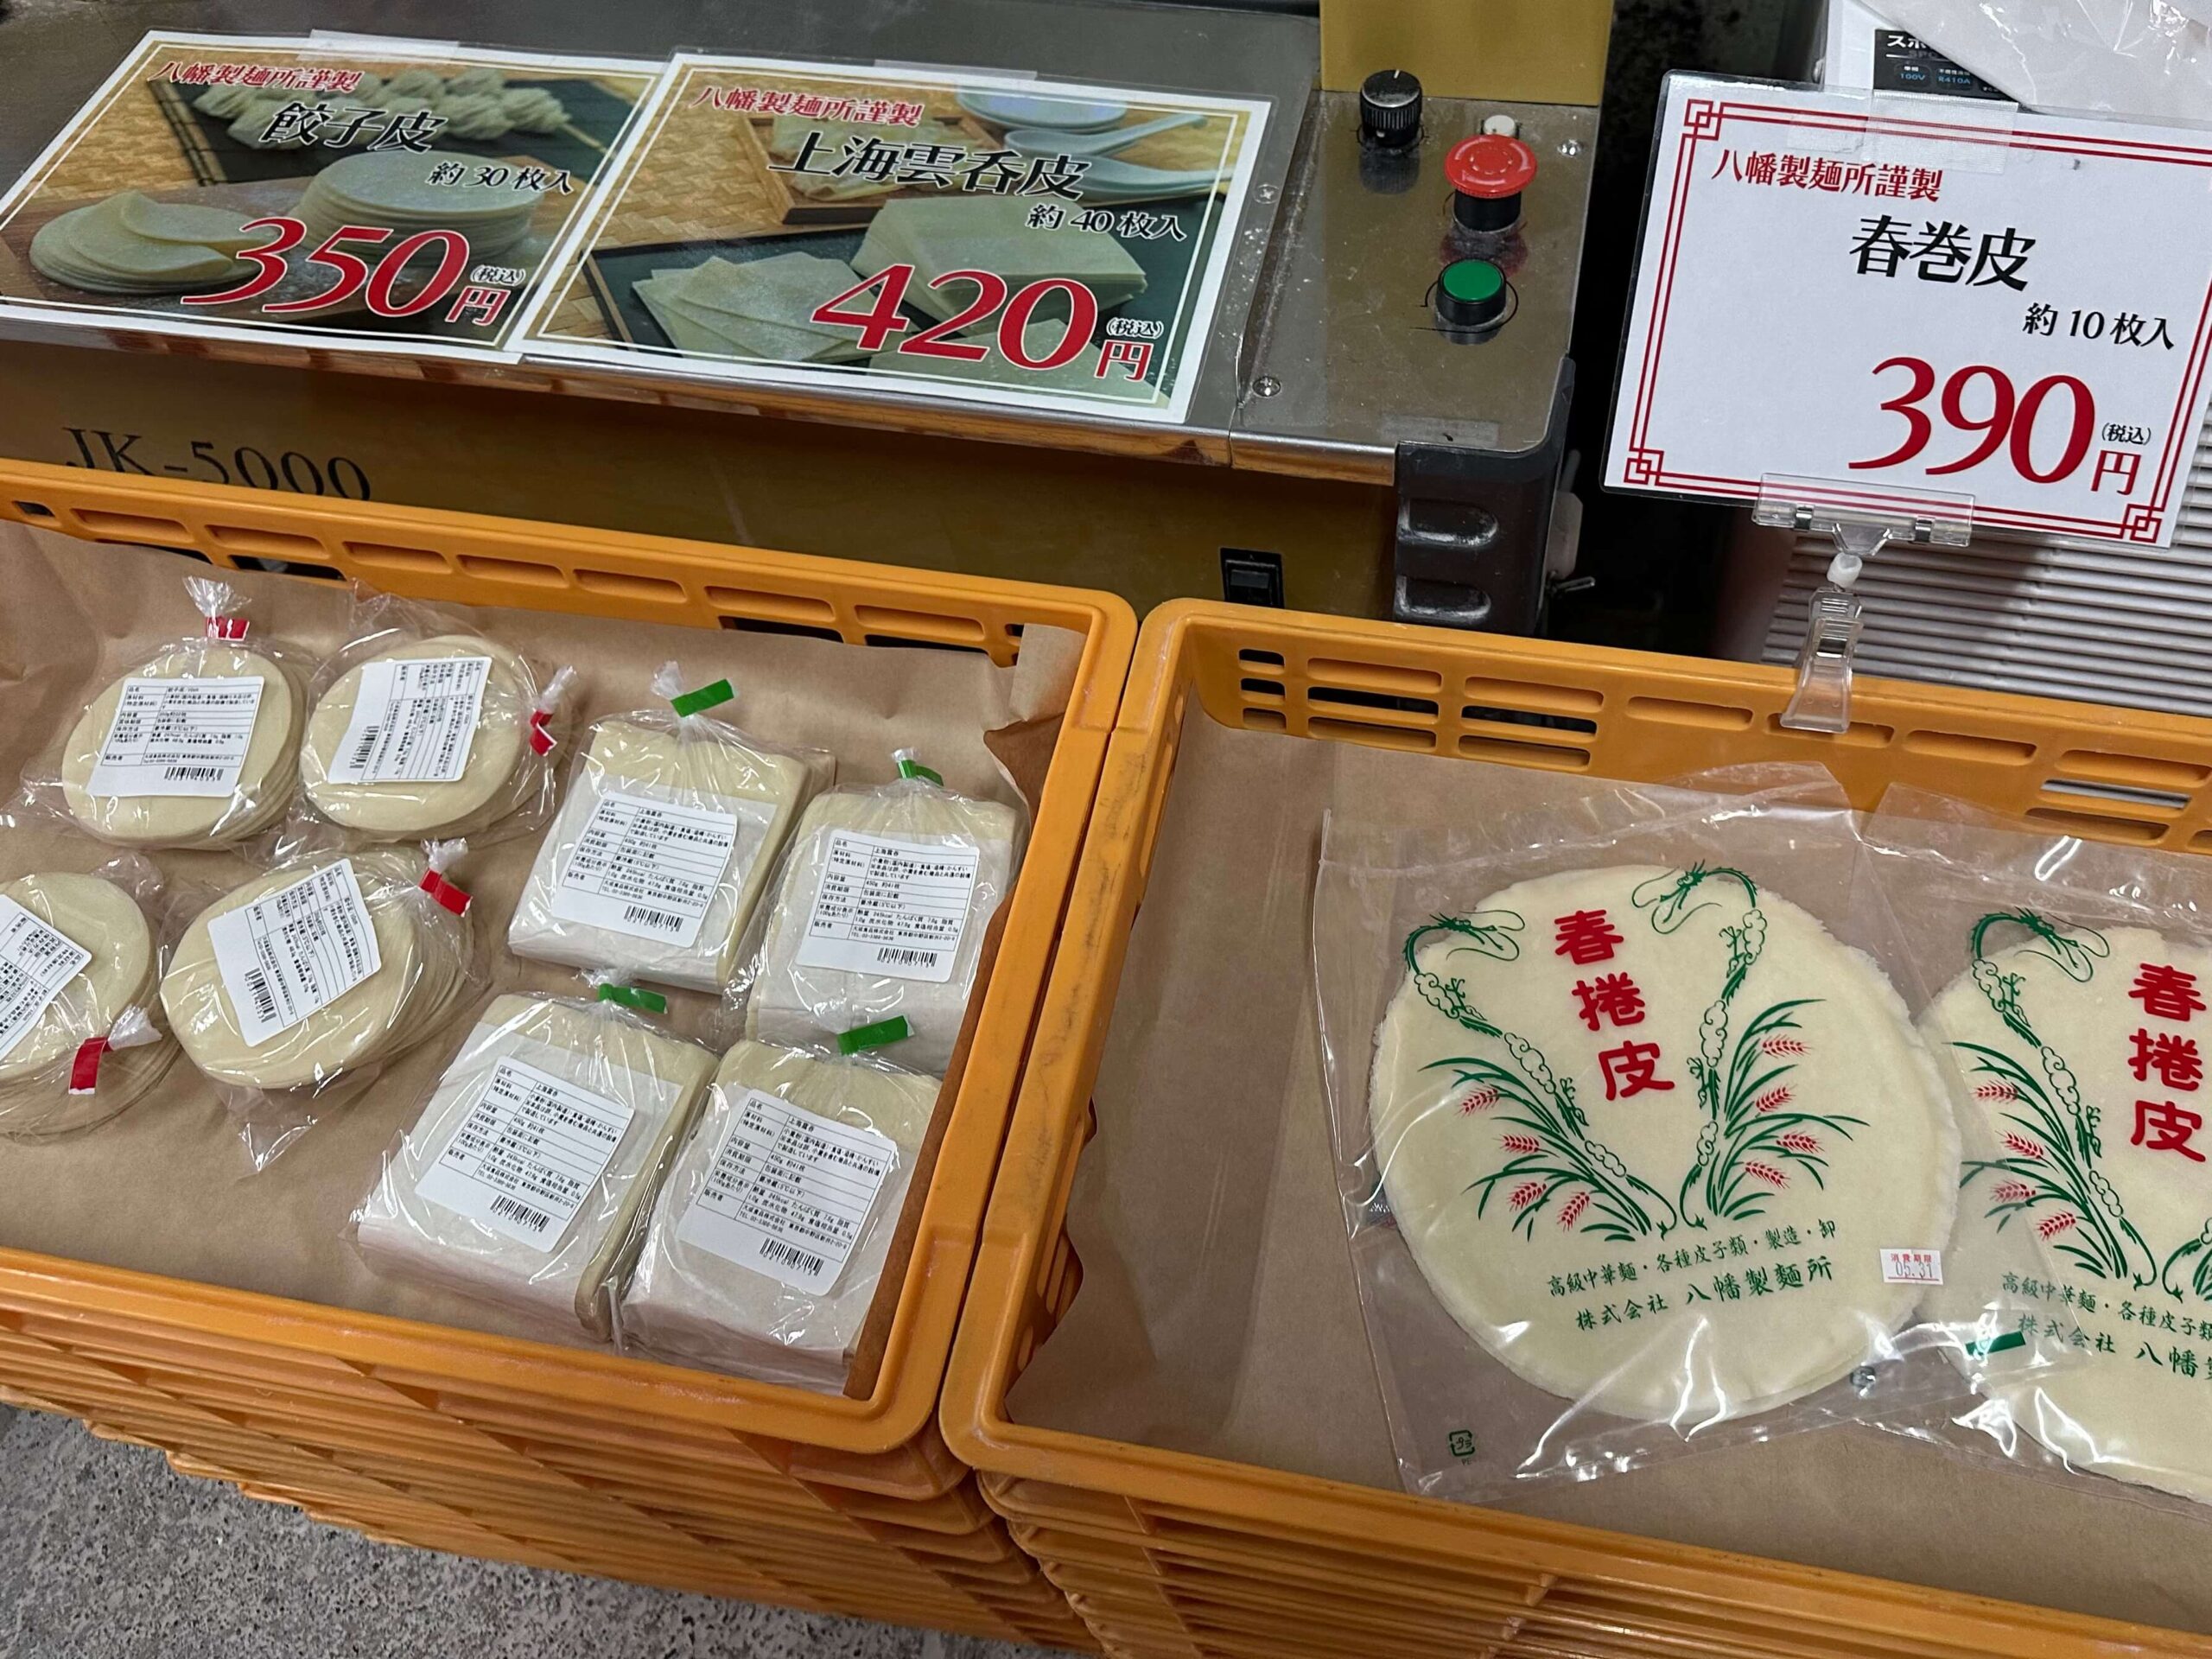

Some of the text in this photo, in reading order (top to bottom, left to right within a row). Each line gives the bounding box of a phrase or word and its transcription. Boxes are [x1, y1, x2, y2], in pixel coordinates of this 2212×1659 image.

[147, 60, 365, 93] 八幡製麺所謹製
[694, 87, 925, 127] 八幡製麺所謹製
[259, 100, 448, 154] 餃子皮
[769, 131, 1093, 200] 上海雲呑皮
[1711, 149, 1943, 203] 八幡製麺所謹製
[180, 218, 508, 326] 350 円
[1849, 214, 2037, 292] 春巻皮
[810, 264, 1154, 382] 420 円
[1848, 356, 2141, 496] 390 円
[61, 427, 372, 501] JK-5000
[1554, 909, 1675, 1102] 春捲皮
[2127, 962, 2208, 1163] 春捲皮
[1575, 1294, 1669, 1331] 株式会社
[2018, 1313, 2116, 1354] 株式会社
